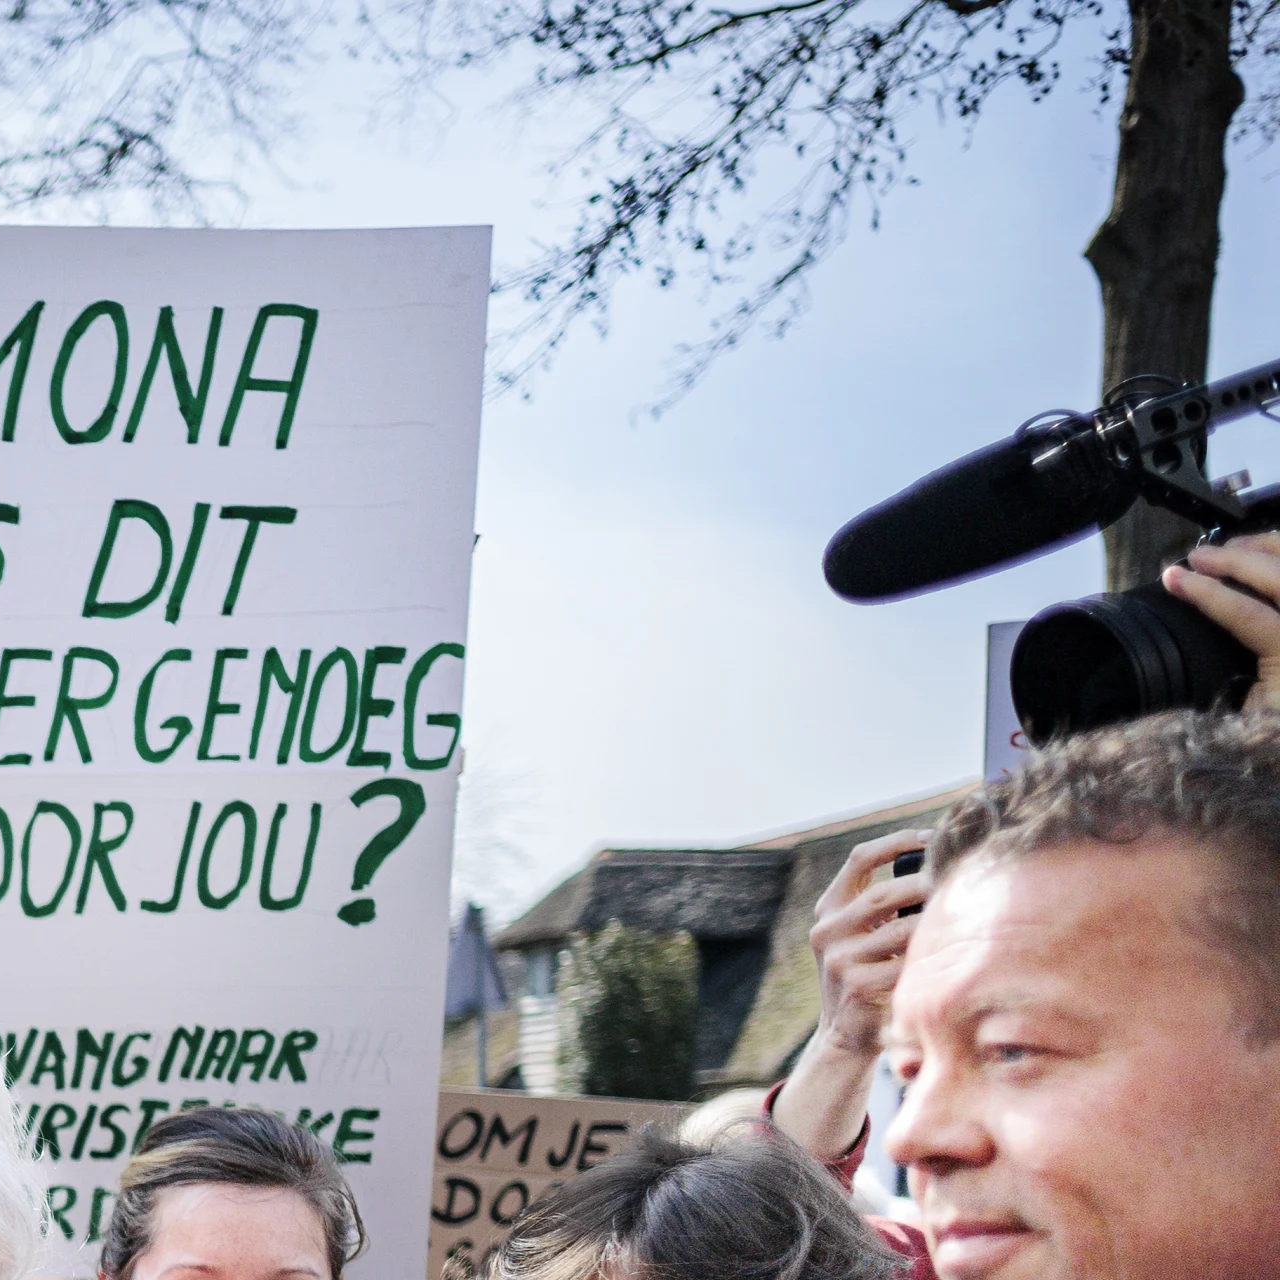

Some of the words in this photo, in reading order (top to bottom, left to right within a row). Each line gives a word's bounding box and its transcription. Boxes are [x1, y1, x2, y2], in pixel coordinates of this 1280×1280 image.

[83, 499, 298, 624] DIT
[157, 1024, 319, 1085] NAAR
[439, 1108, 539, 1164] OM
